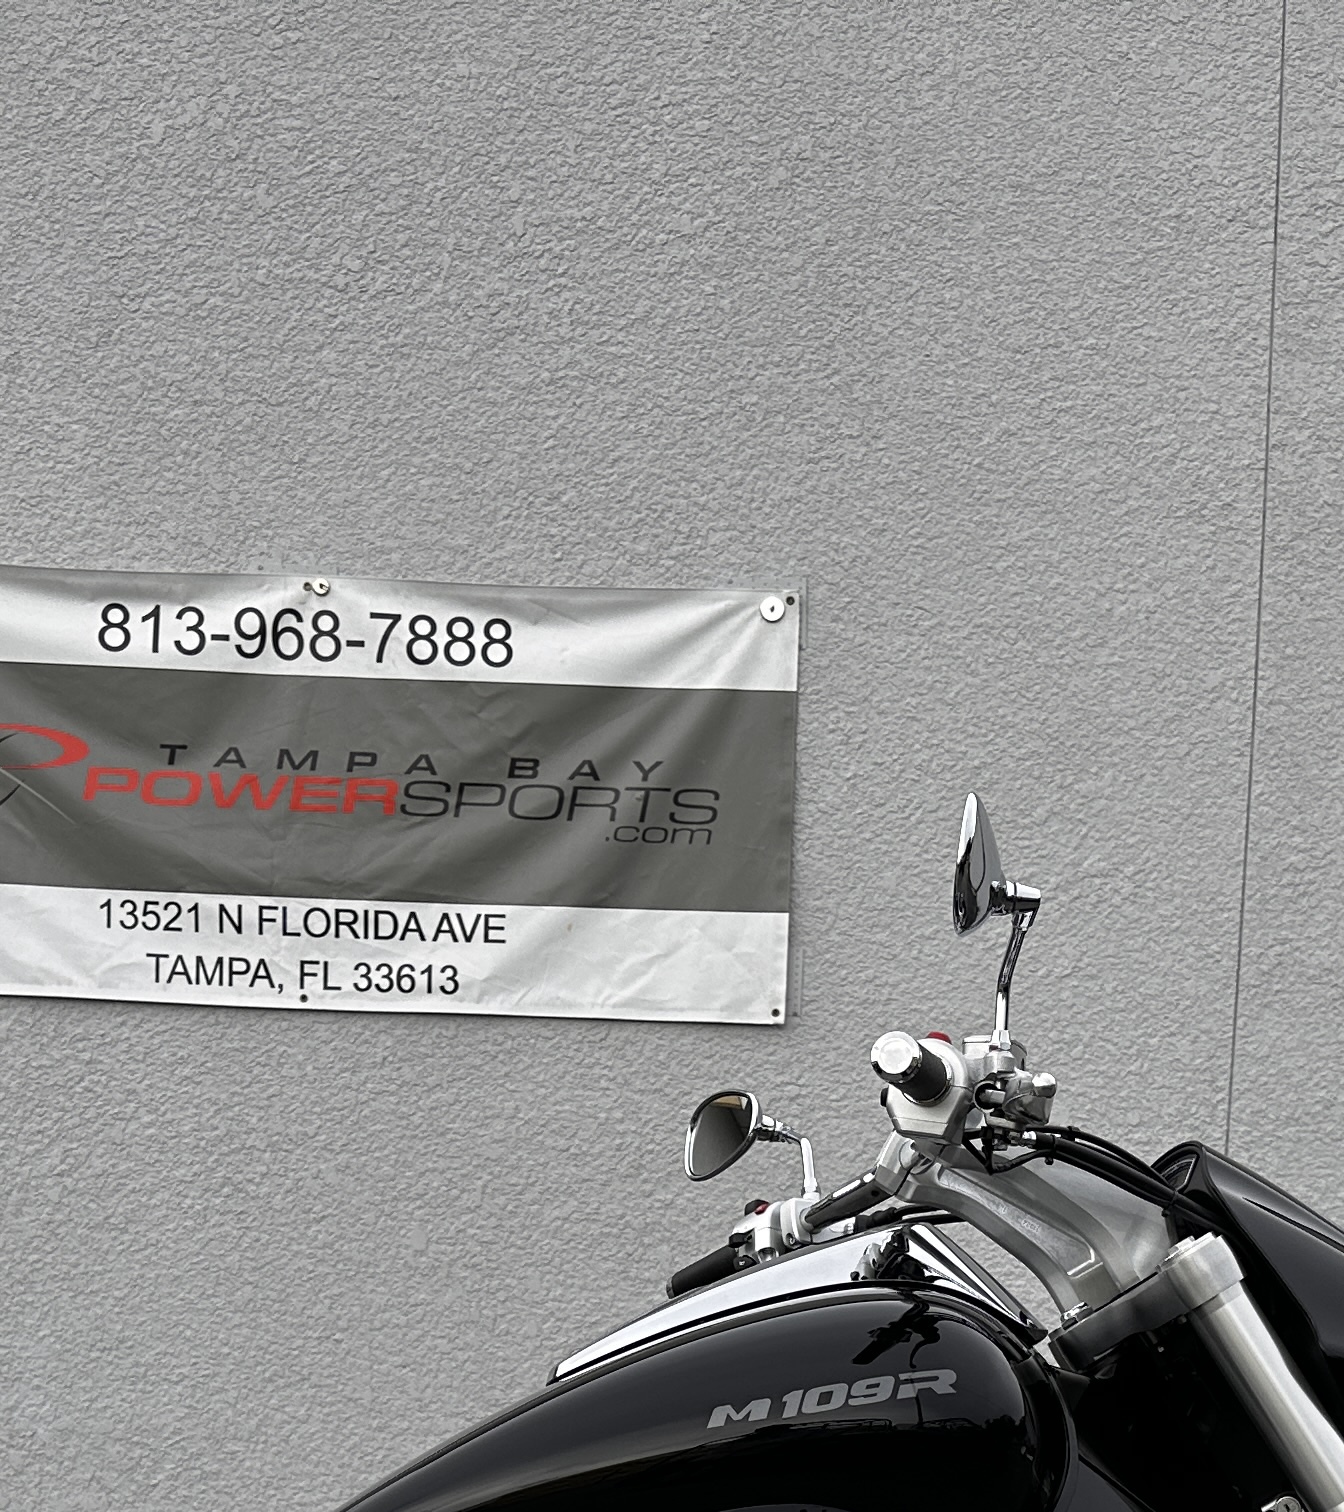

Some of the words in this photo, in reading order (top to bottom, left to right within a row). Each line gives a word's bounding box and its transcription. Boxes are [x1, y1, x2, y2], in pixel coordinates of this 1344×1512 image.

[97, 602, 515, 668] 813-968-7888
[159, 743, 439, 776] TAMPA
[506, 756, 664, 782] BAY
[81, 766, 721, 827] POWERSPORTS
[603, 823, 712, 845] .com
[98, 898, 202, 933] 13521
[217, 903, 244, 935] N
[257, 905, 427, 942] FLORIDA
[432, 912, 507, 944] AVE
[145, 952, 285, 993] TAMPA,
[299, 960, 342, 991] FL
[352, 962, 460, 995] 33613
